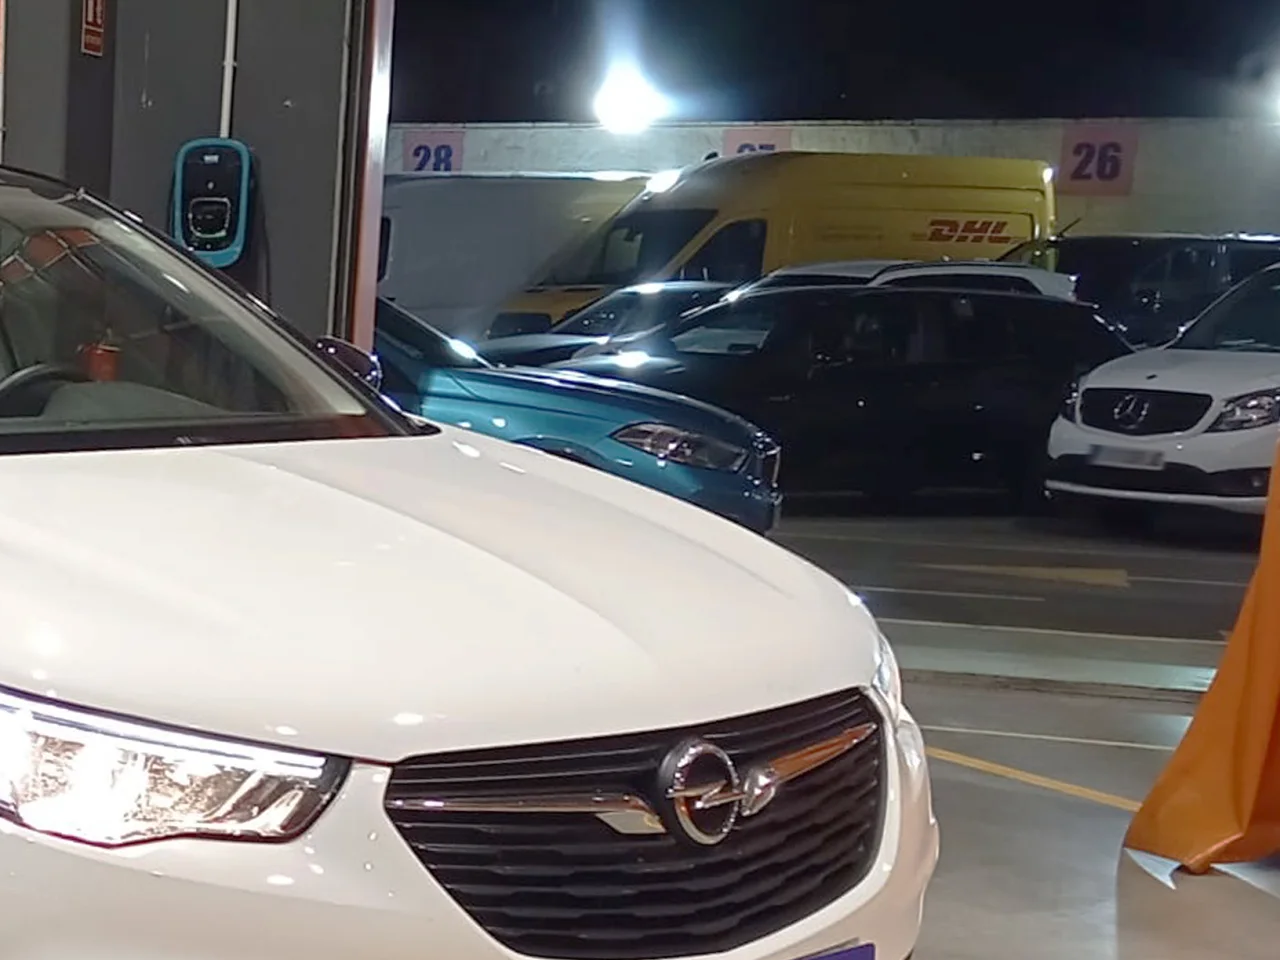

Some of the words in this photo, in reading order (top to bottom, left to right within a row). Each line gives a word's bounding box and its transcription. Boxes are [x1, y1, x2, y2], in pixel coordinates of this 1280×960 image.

[412, 144, 452, 172] 28
[1071, 142, 1121, 181] 26
[928, 219, 1013, 243] DHL
